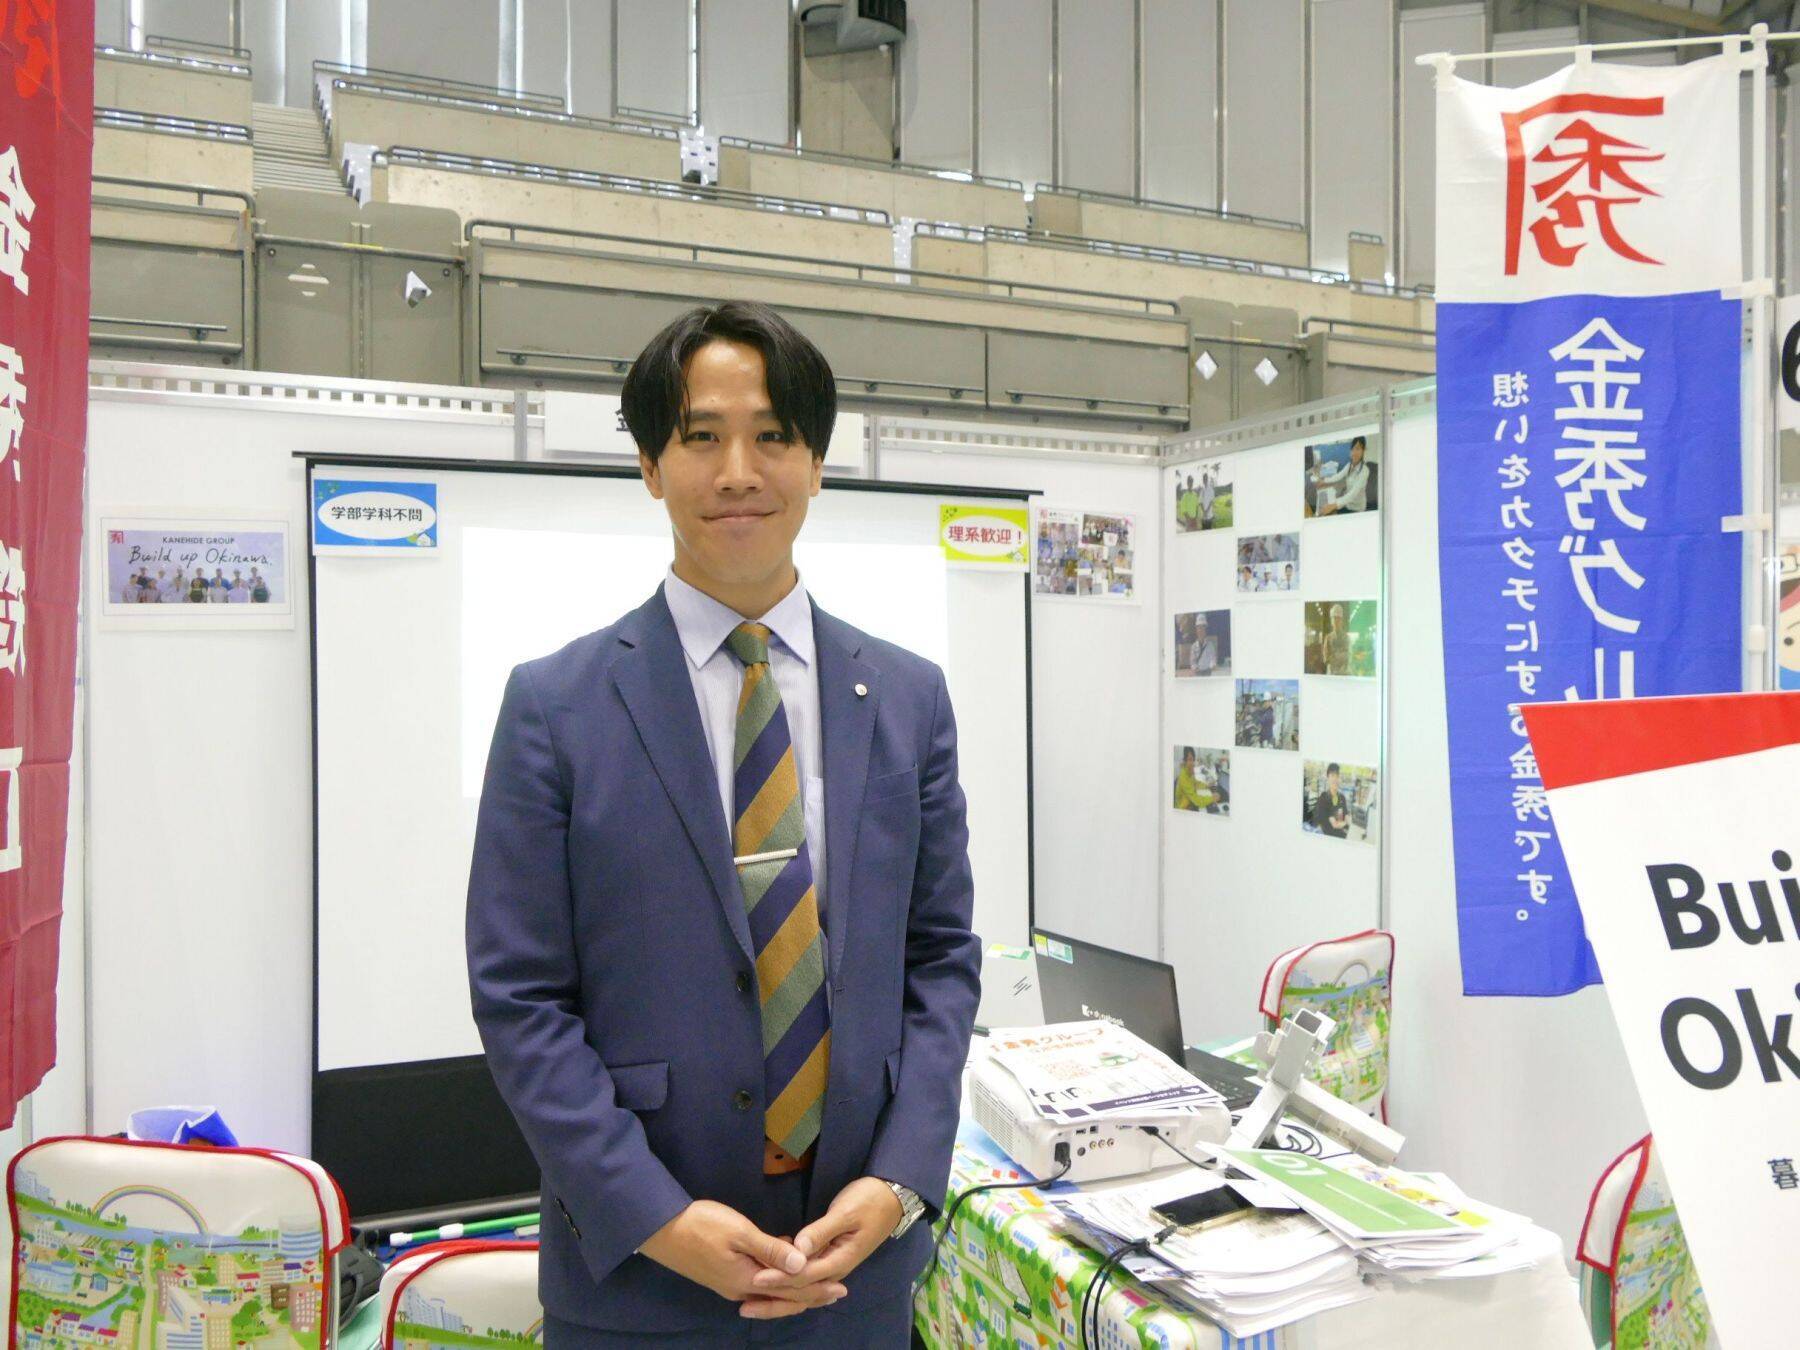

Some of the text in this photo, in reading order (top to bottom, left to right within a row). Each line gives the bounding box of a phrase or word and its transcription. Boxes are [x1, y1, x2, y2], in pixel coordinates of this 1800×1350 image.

[331, 506, 422, 521] 学部学科不問
[162, 536, 235, 545] KANEHIDE GROUP
[128, 546, 171, 564] Build
[180, 551, 198, 568] up
[1660, 982, 1800, 1091] Ok
